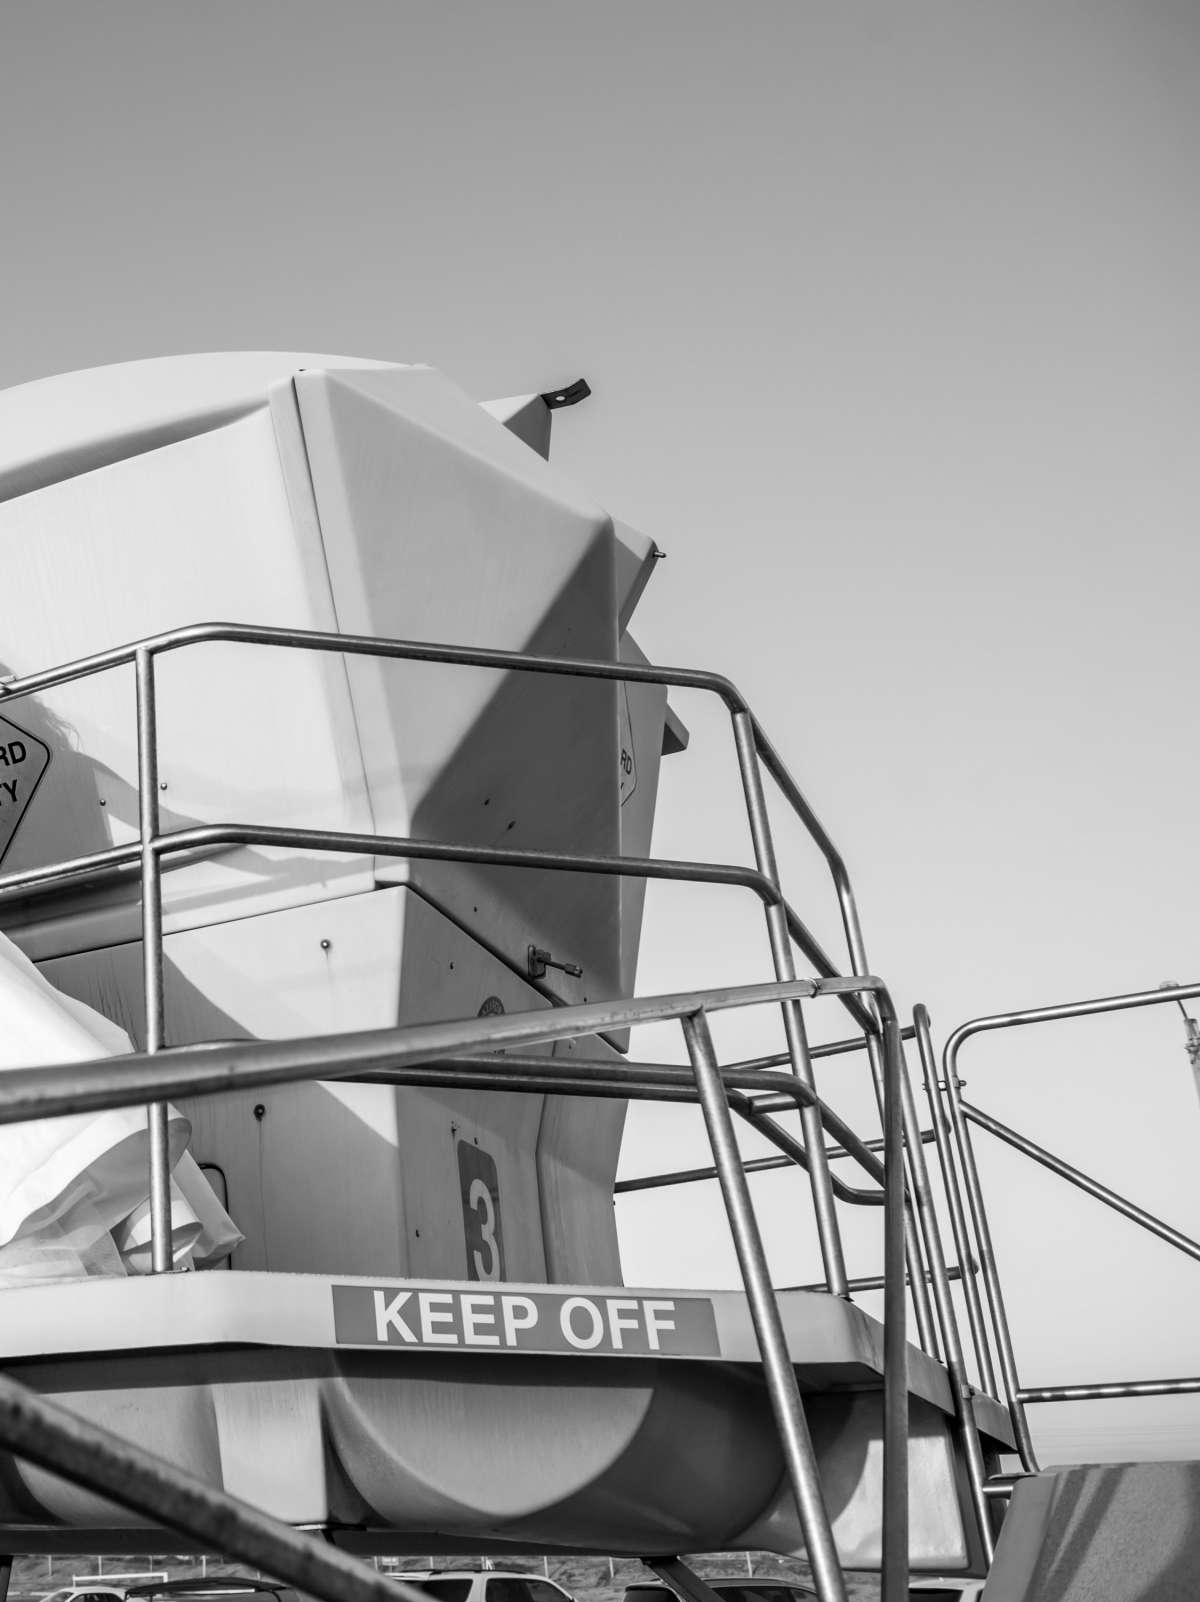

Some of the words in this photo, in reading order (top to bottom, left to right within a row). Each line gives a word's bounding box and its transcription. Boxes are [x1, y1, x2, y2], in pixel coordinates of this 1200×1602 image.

[469, 1178, 501, 1282] 3
[373, 1289, 539, 1347] KEEP
[559, 1296, 676, 1350] OFF
